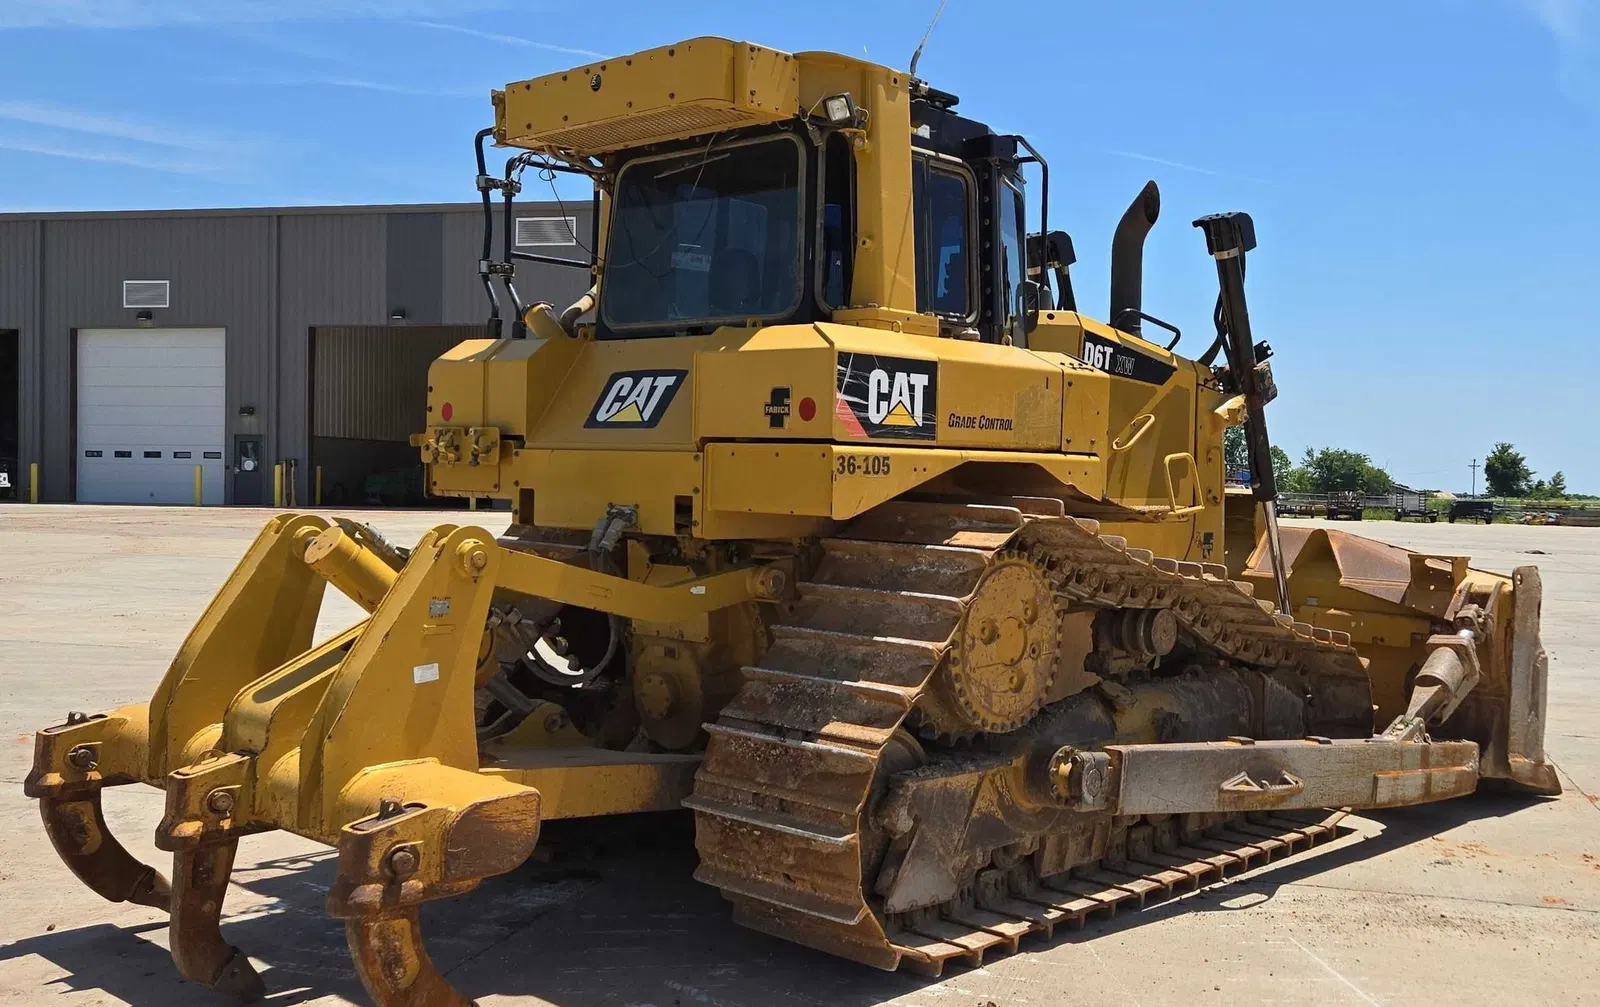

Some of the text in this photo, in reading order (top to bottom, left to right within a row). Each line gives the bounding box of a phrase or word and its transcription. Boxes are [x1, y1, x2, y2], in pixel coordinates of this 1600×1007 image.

[1083, 341, 1114, 371] D6T
[596, 375, 677, 422] CAT
[765, 405, 790, 414] FABICK
[868, 368, 929, 427] CAT
[836, 455, 891, 475] 36-105
